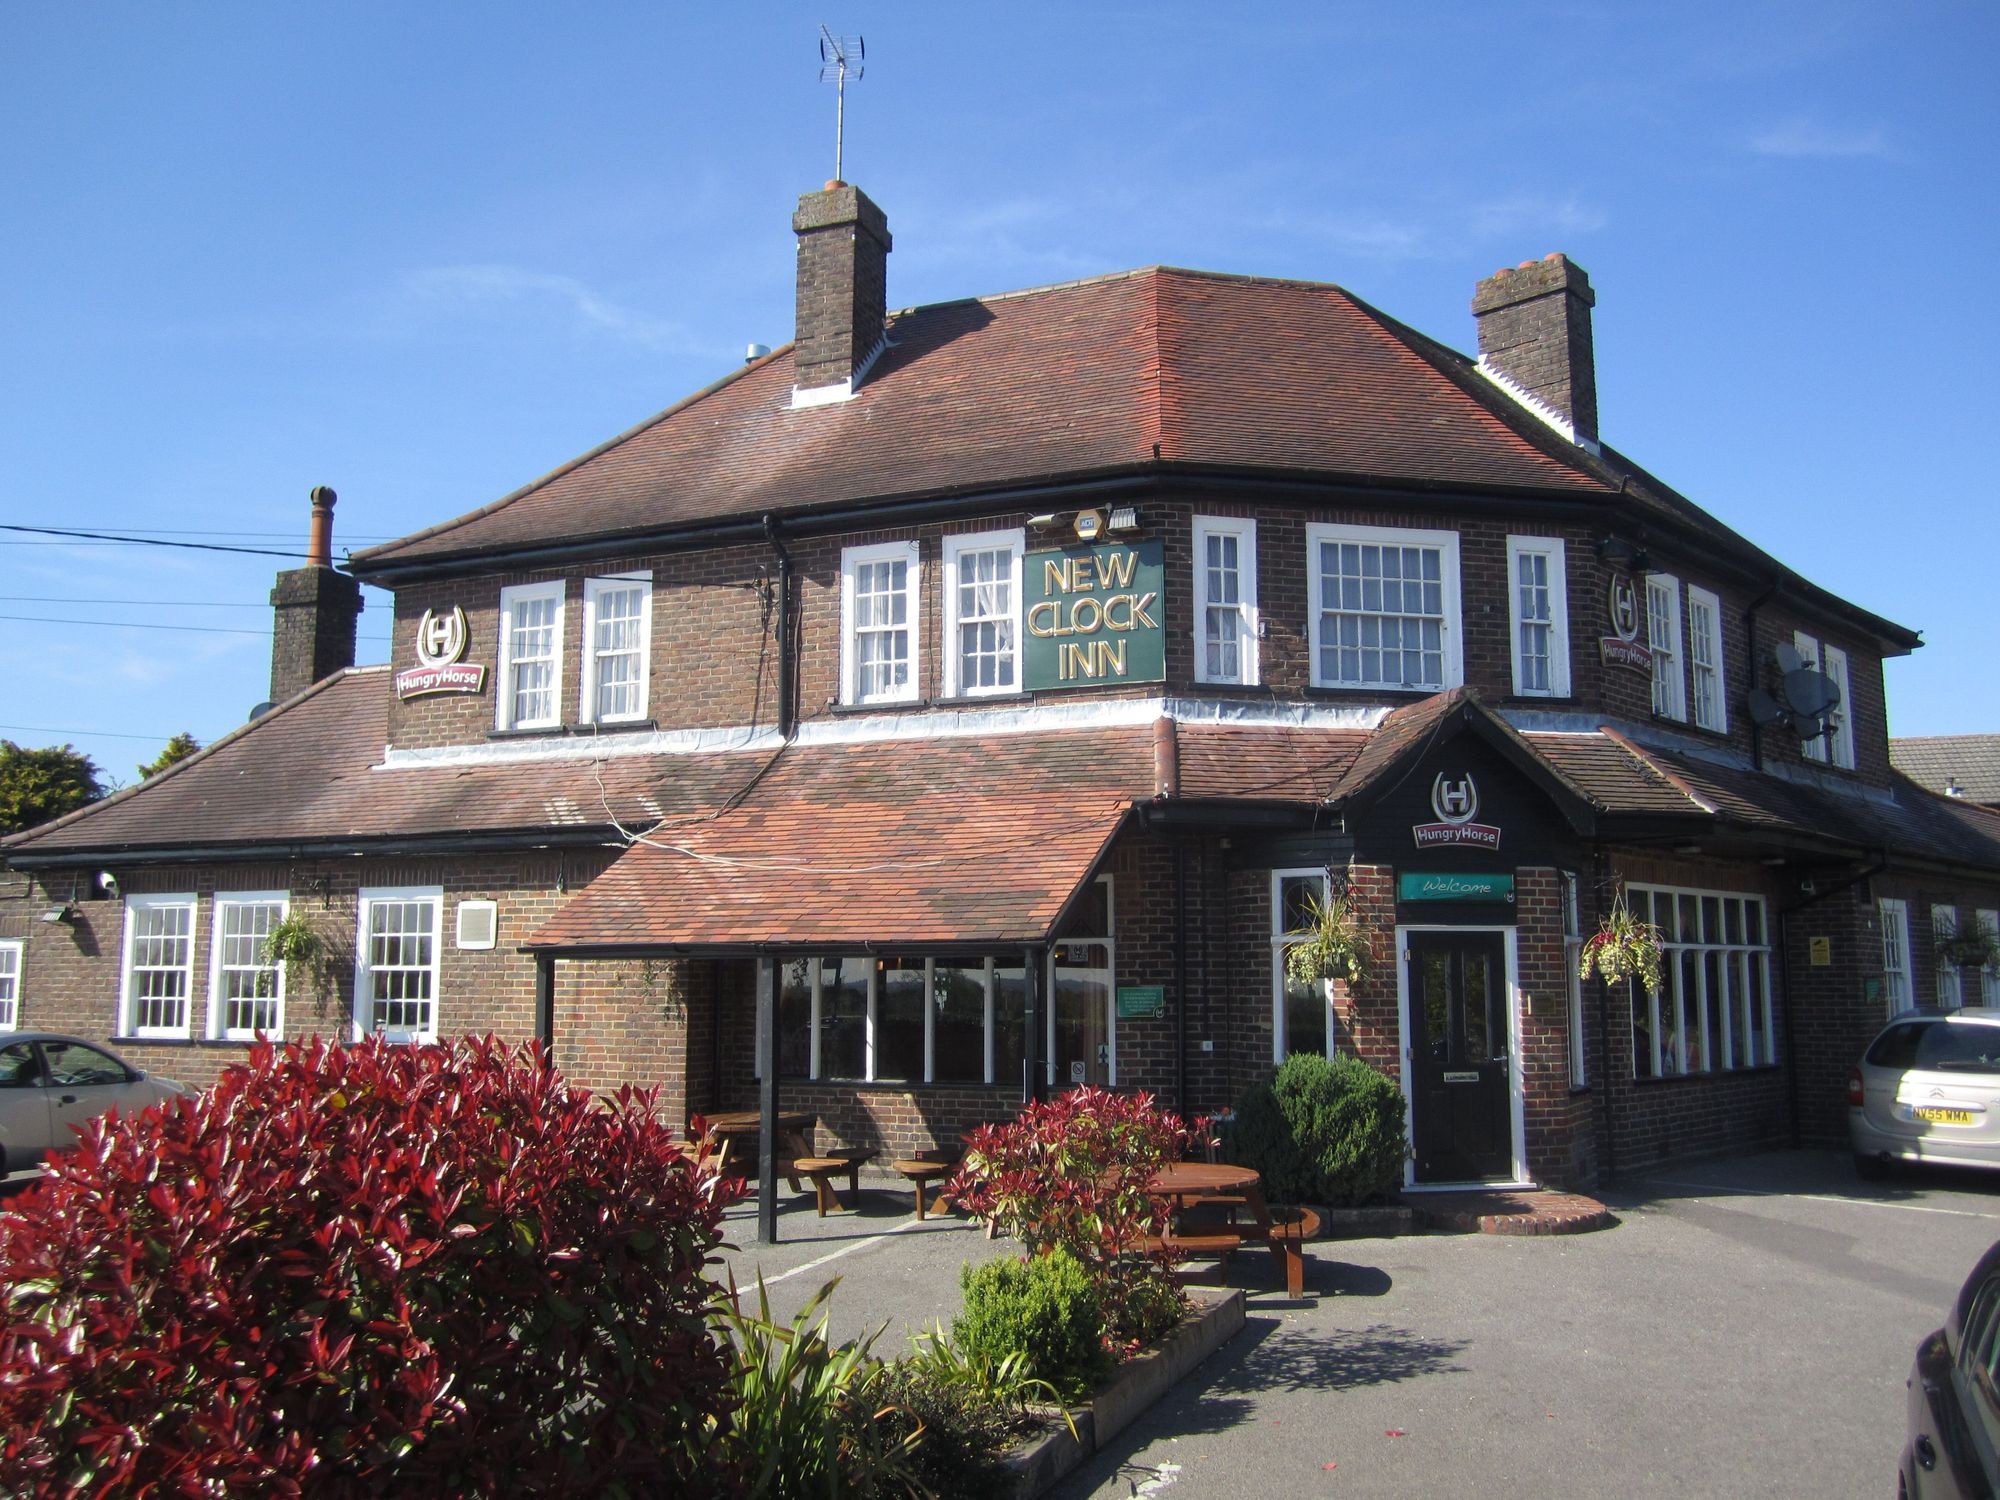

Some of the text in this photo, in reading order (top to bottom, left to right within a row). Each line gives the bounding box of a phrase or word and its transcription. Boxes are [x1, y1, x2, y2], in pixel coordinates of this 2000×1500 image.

[1044, 551, 1139, 596] NEW
[1028, 592, 1159, 638] CLOCK
[1059, 639, 1127, 680] INN
[1422, 877, 1492, 893] Welcome
[1913, 1107, 1969, 1122] NV55 WMA
